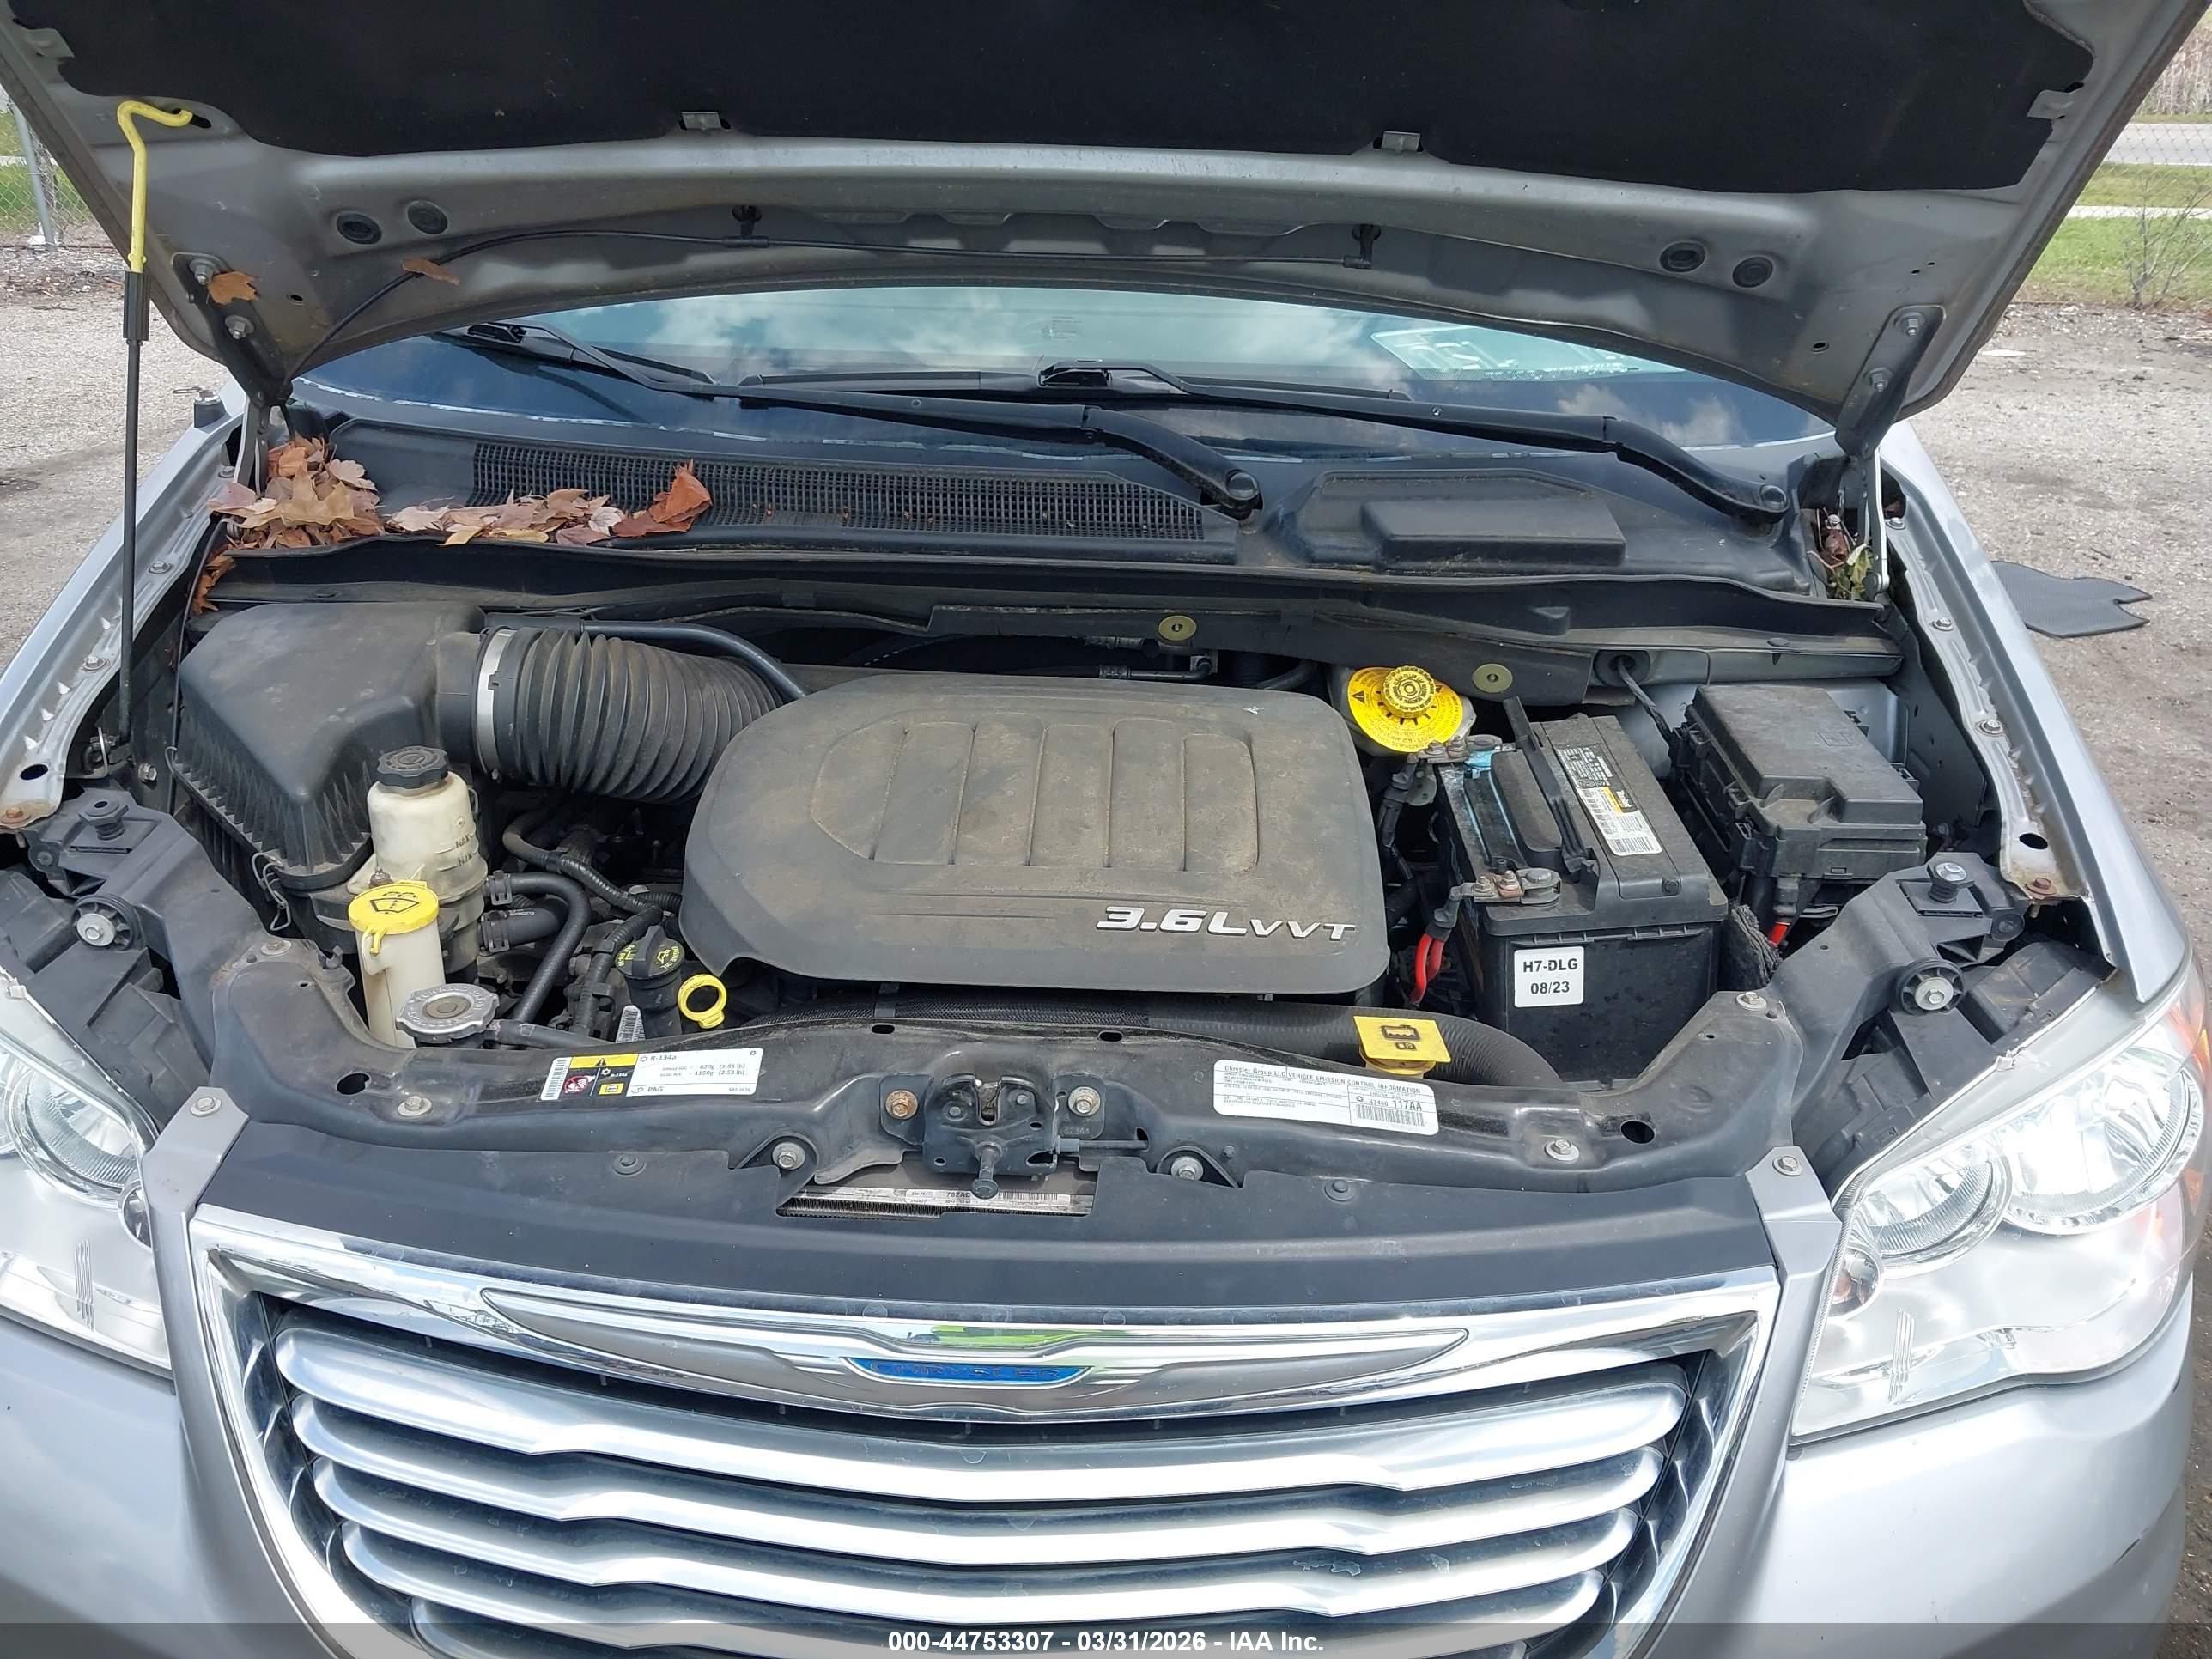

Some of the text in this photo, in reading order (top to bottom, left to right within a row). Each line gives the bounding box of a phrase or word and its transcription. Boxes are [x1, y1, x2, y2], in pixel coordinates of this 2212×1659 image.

[1522, 958, 1578, 973] H7-DLG
[1530, 981, 1570, 994] 08/23
[1224, 1066, 1251, 1074] Chrysler
[1253, 1067, 1273, 1077] Group
[1288, 1072, 1313, 1080] VEHICLE
[1316, 1074, 1346, 1084] EMISSION
[1347, 1079, 1376, 1088] CONTROL
[1377, 1083, 1421, 1093] INFORMATION
